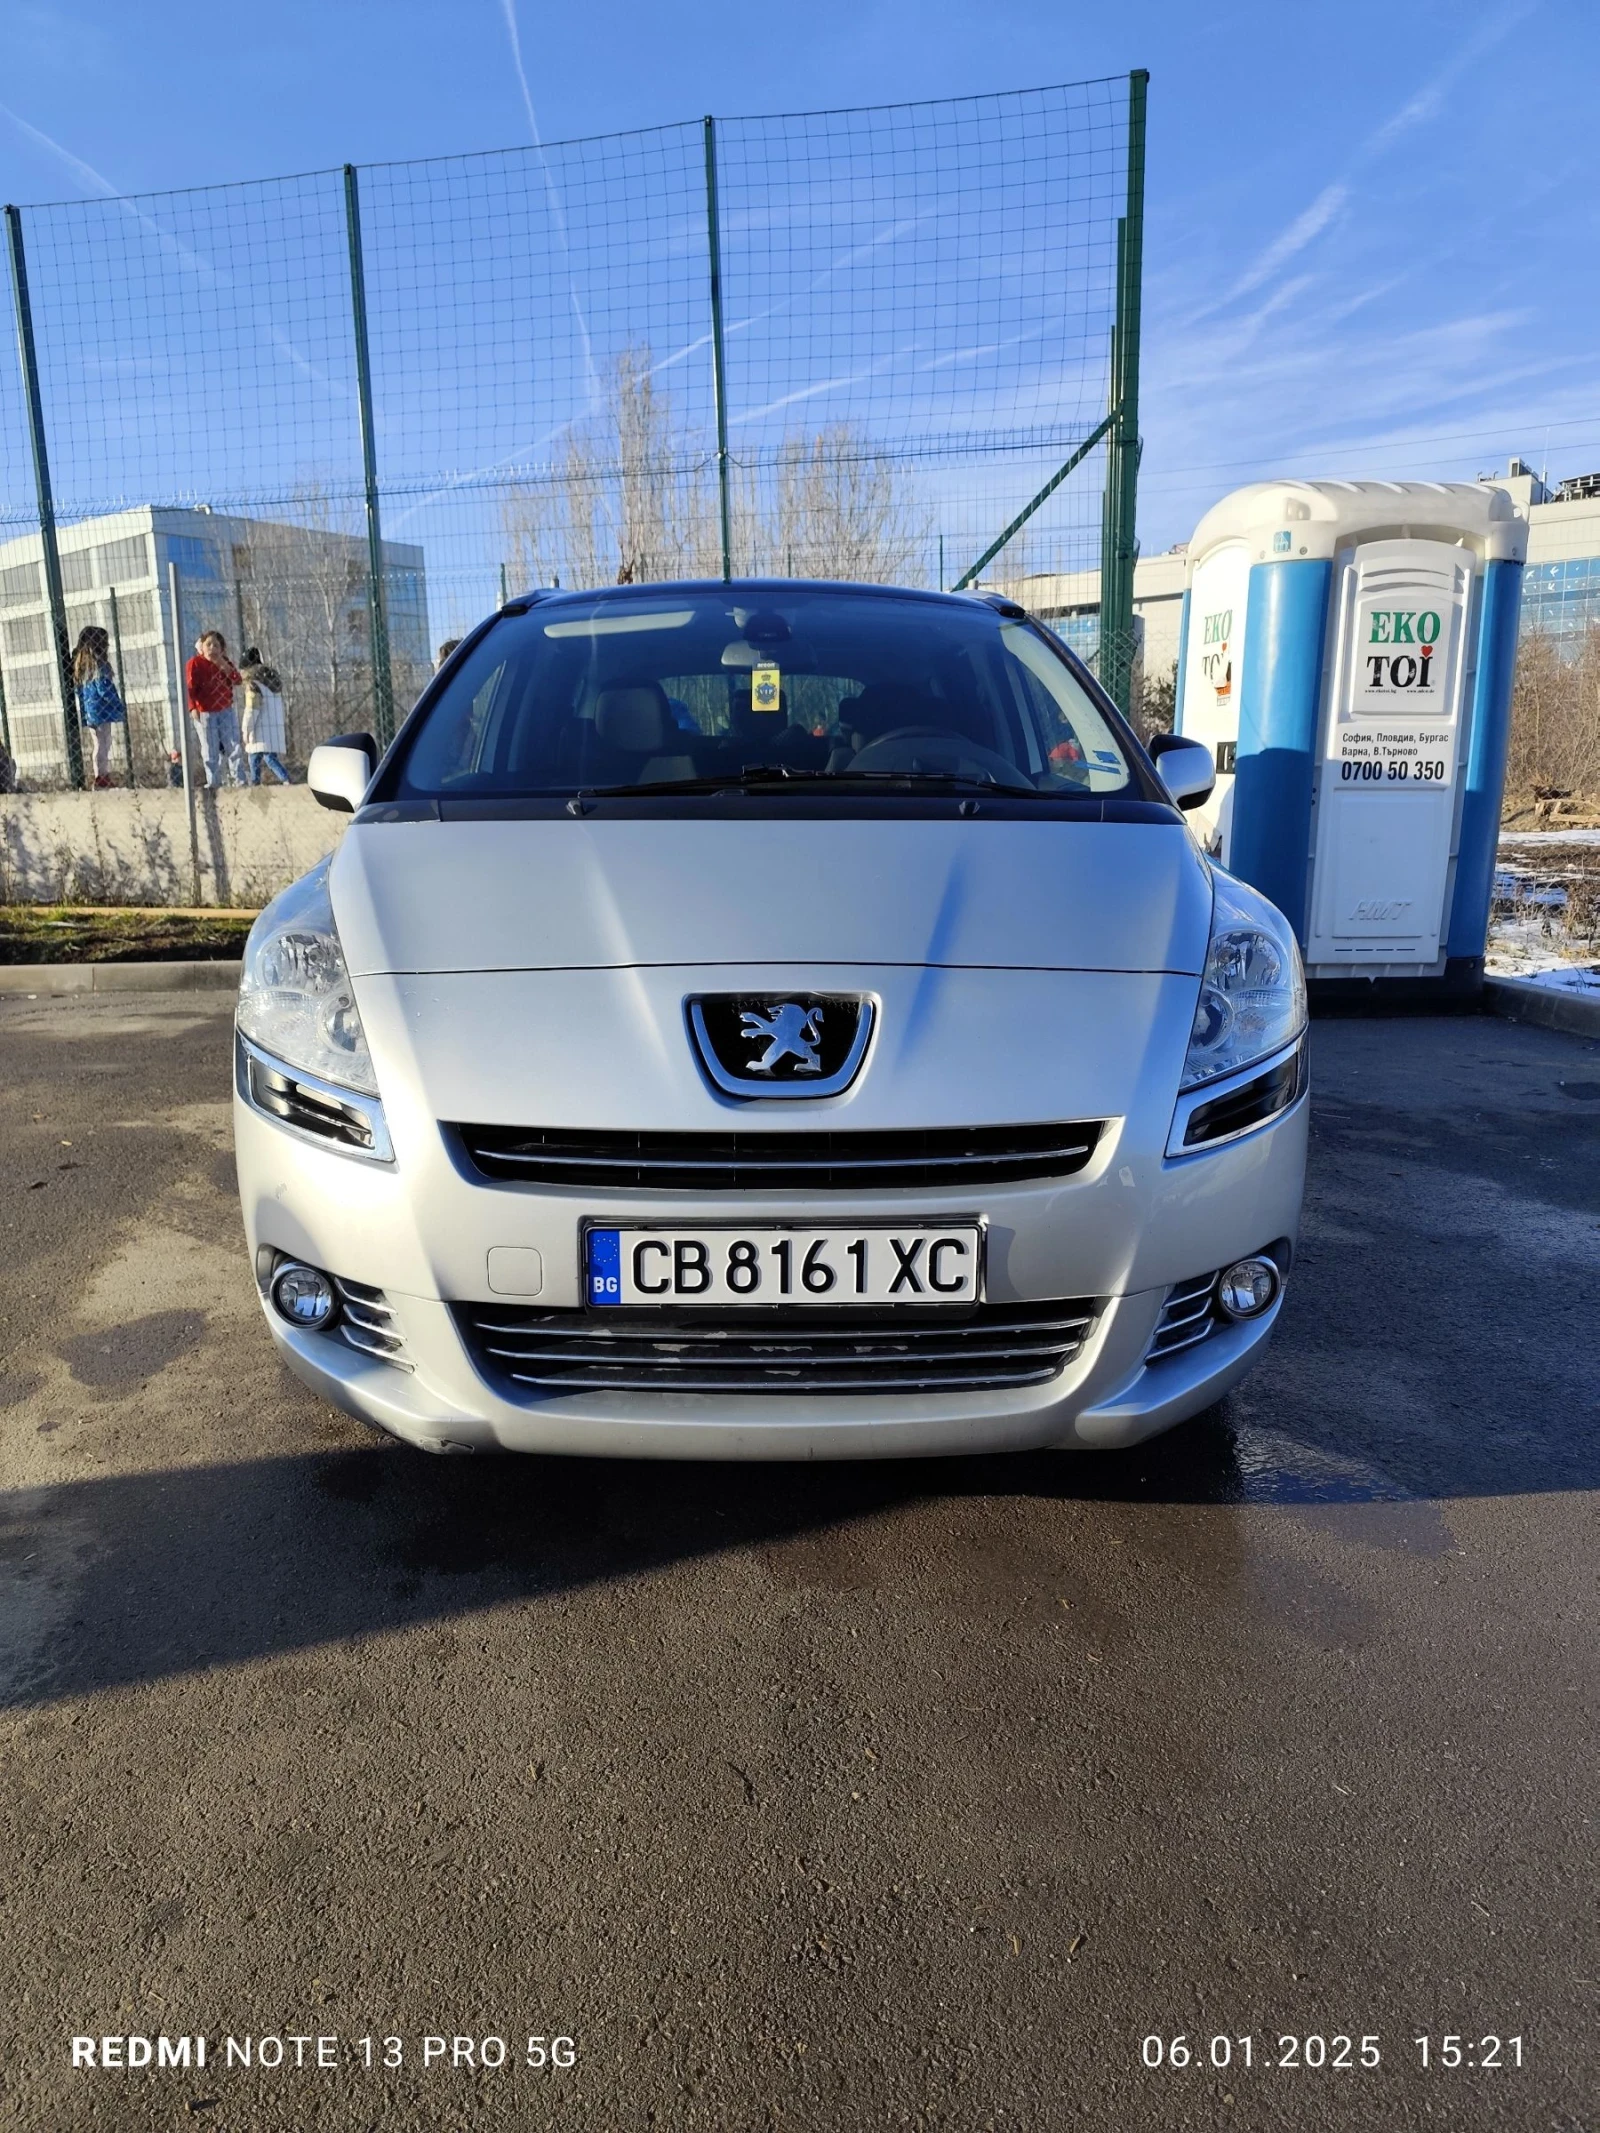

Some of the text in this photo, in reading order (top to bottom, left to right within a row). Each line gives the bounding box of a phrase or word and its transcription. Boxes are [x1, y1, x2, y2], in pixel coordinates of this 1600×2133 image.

[1204, 609, 1233, 645] EKO
[1369, 611, 1441, 644] EKO
[1342, 733, 1449, 744] София, Пловдив, Бургас
[1341, 747, 1418, 757] Варна, В.Търново
[1341, 761, 1445, 780] 0700 50 350
[593, 1277, 618, 1293] BG
